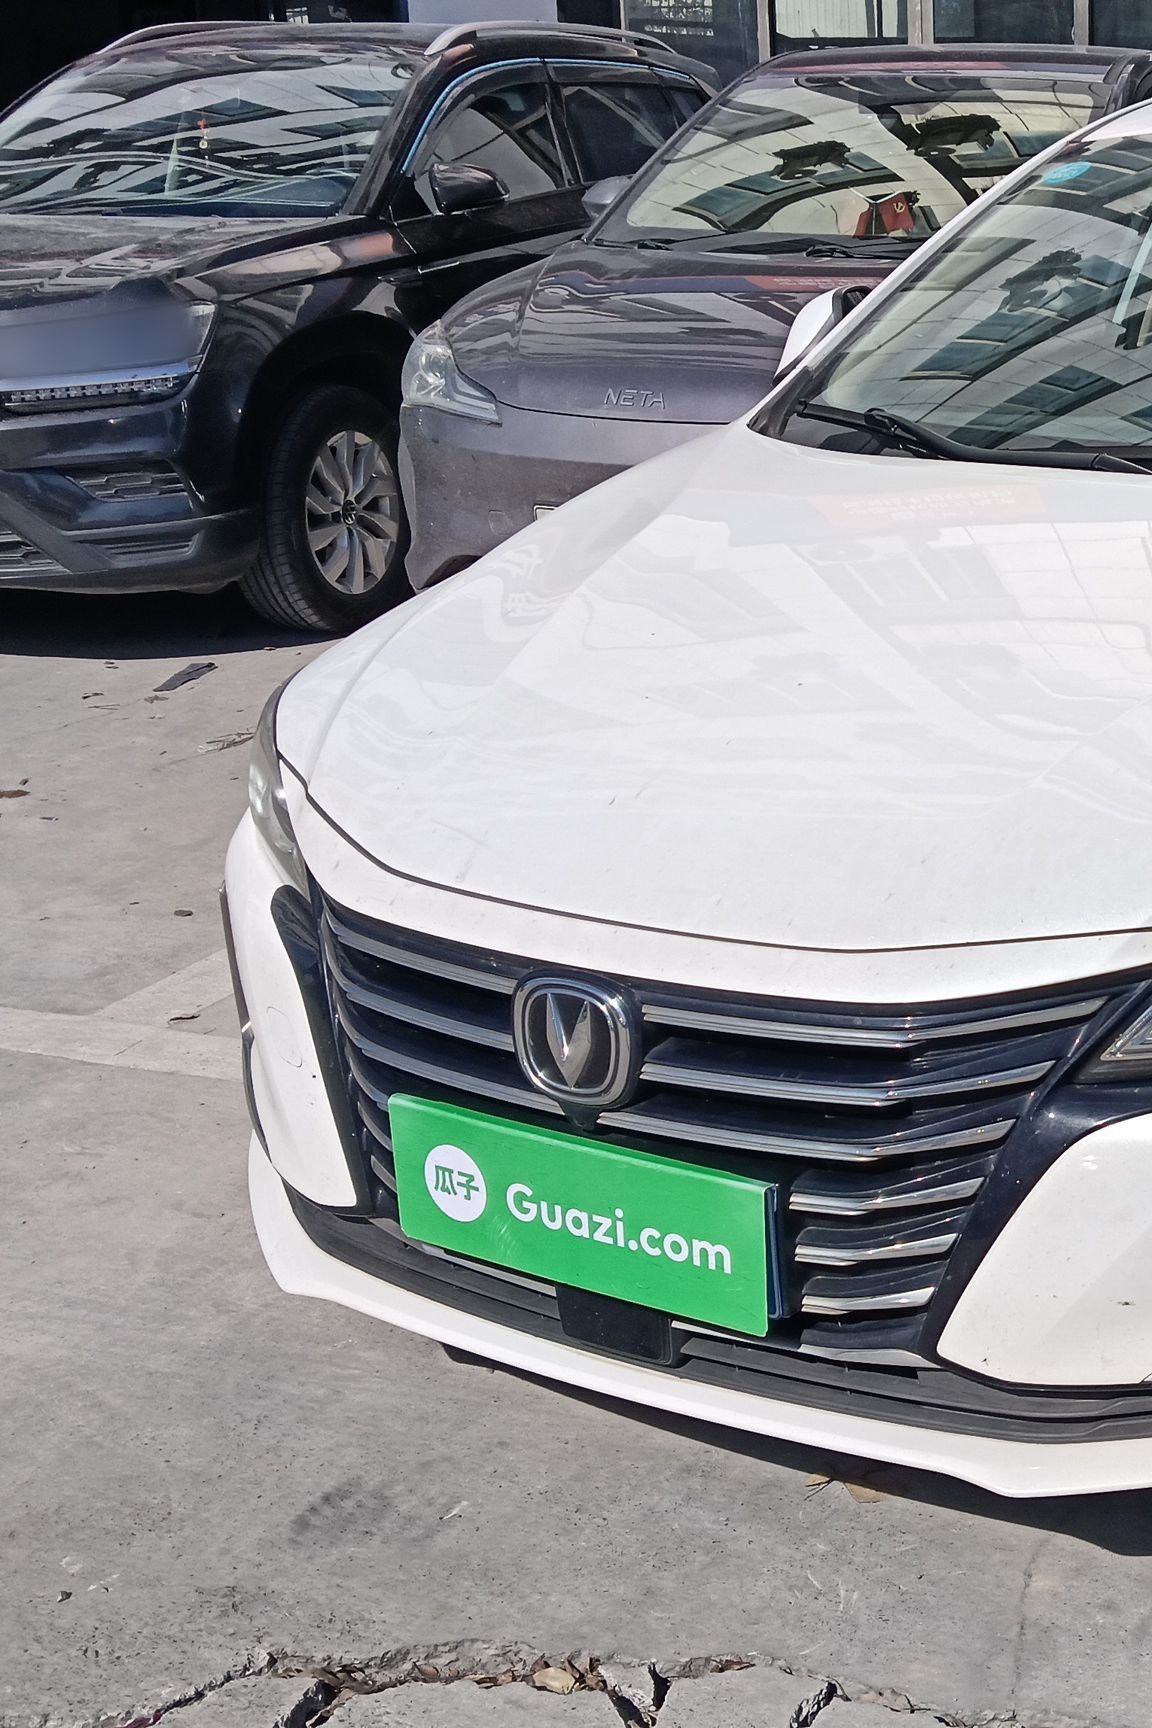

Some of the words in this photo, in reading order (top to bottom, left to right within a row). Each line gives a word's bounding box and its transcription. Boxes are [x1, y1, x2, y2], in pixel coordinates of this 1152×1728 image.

[604, 388, 666, 409] NETA
[434, 1165, 479, 1200] 瓜子
[506, 1182, 732, 1275] Guazi.com
